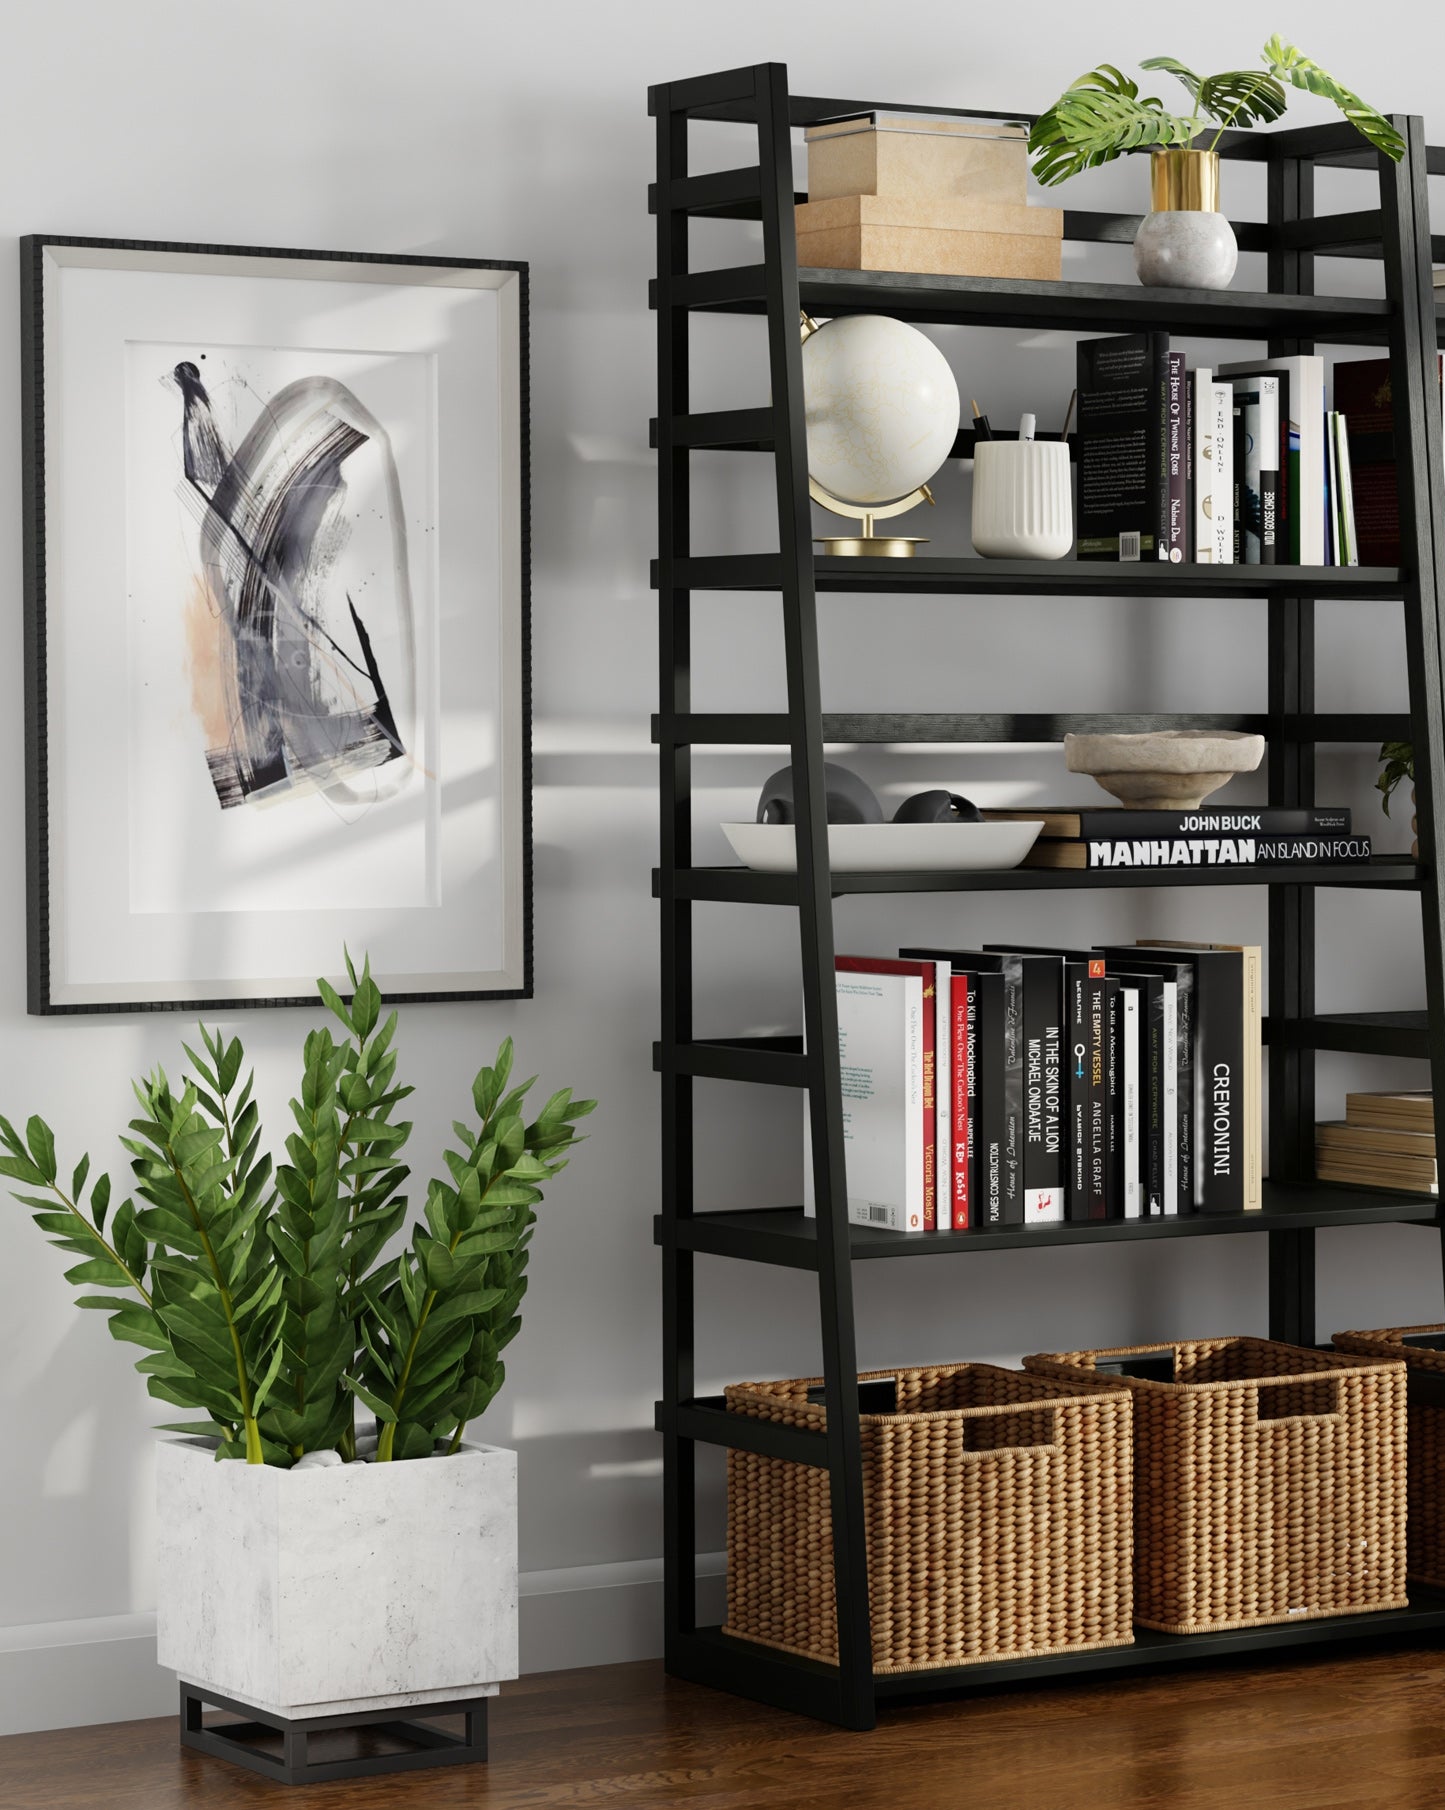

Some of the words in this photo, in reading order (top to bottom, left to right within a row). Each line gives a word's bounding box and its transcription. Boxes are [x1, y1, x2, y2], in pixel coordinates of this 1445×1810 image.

[1170, 359, 1181, 374] THE
[1170, 377, 1181, 401] HOUSE
[1160, 403, 1168, 424] FROM
[1170, 403, 1181, 416] OF
[1170, 418, 1181, 451] TWINING
[1160, 428, 1168, 479] EVERYWHERE
[1170, 453, 1181, 475] ROSES
[1264, 491, 1275, 510] CHASE
[1170, 499, 1181, 524] Nabina
[1264, 511, 1275, 530] GOOSE
[1170, 527, 1181, 542] Das
[1264, 531, 1275, 545] WILD
[1179, 816, 1220, 831] JOHN
[1221, 815, 1262, 830] BUCK
[1090, 838, 1256, 867] MANHATTAN
[1257, 843, 1275, 859] AN
[1278, 842, 1318, 859] ISLAND
[1320, 842, 1332, 858] IN
[1333, 841, 1370, 857] FOCUS
[1093, 962, 1102, 975] 4
[968, 990, 976, 1003] To
[1092, 991, 1102, 1010] THE
[1109, 996, 1117, 1008] To
[956, 1006, 966, 1021] One
[968, 1006, 976, 1021] Kill
[1109, 1011, 1117, 1025] Kill
[956, 1023, 966, 1040] Flew
[1046, 1027, 1059, 1038] IN
[1092, 1013, 1102, 1047] EMPTY
[1152, 1028, 1160, 1048] AWAY
[924, 1051, 934, 1062] The
[956, 1043, 966, 1061] Over
[1029, 1039, 1040, 1084] MICHAEL
[1046, 1041, 1059, 1064] THE
[1152, 1051, 1160, 1073] FROM
[924, 1063, 934, 1074] Red
[956, 1063, 966, 1077] The
[968, 1032, 976, 1097] Mockingbird
[1092, 1049, 1102, 1086] VESSEL
[1109, 1035, 1117, 1096] Mockingbird
[924, 1075, 934, 1096] Dragon
[1046, 1067, 1059, 1093] SKIN
[956, 1080, 966, 1112] Cuckoo's
[1046, 1096, 1059, 1112] OF
[1152, 1076, 1160, 1129] EVERYWHERE
[956, 1114, 966, 1131] Nest
[1029, 1088, 1040, 1142] ONDAATJE
[1046, 1115, 1059, 1124] A
[1214, 1064, 1230, 1176] CREMONINI
[1092, 1102, 1102, 1153] ANGELLA
[1046, 1126, 1059, 1153] LION
[924, 1144, 934, 1183] Victoria
[990, 1142, 999, 1195] CONSTRUCTION
[1007, 1158, 1017, 1169] of
[1183, 1154, 1192, 1164] of
[1007, 1173, 1017, 1199] House
[1092, 1159, 1102, 1195] GRAFF
[1183, 1168, 1192, 1191] House
[924, 1187, 934, 1221] Mosley
[990, 1197, 999, 1221] PLANES
